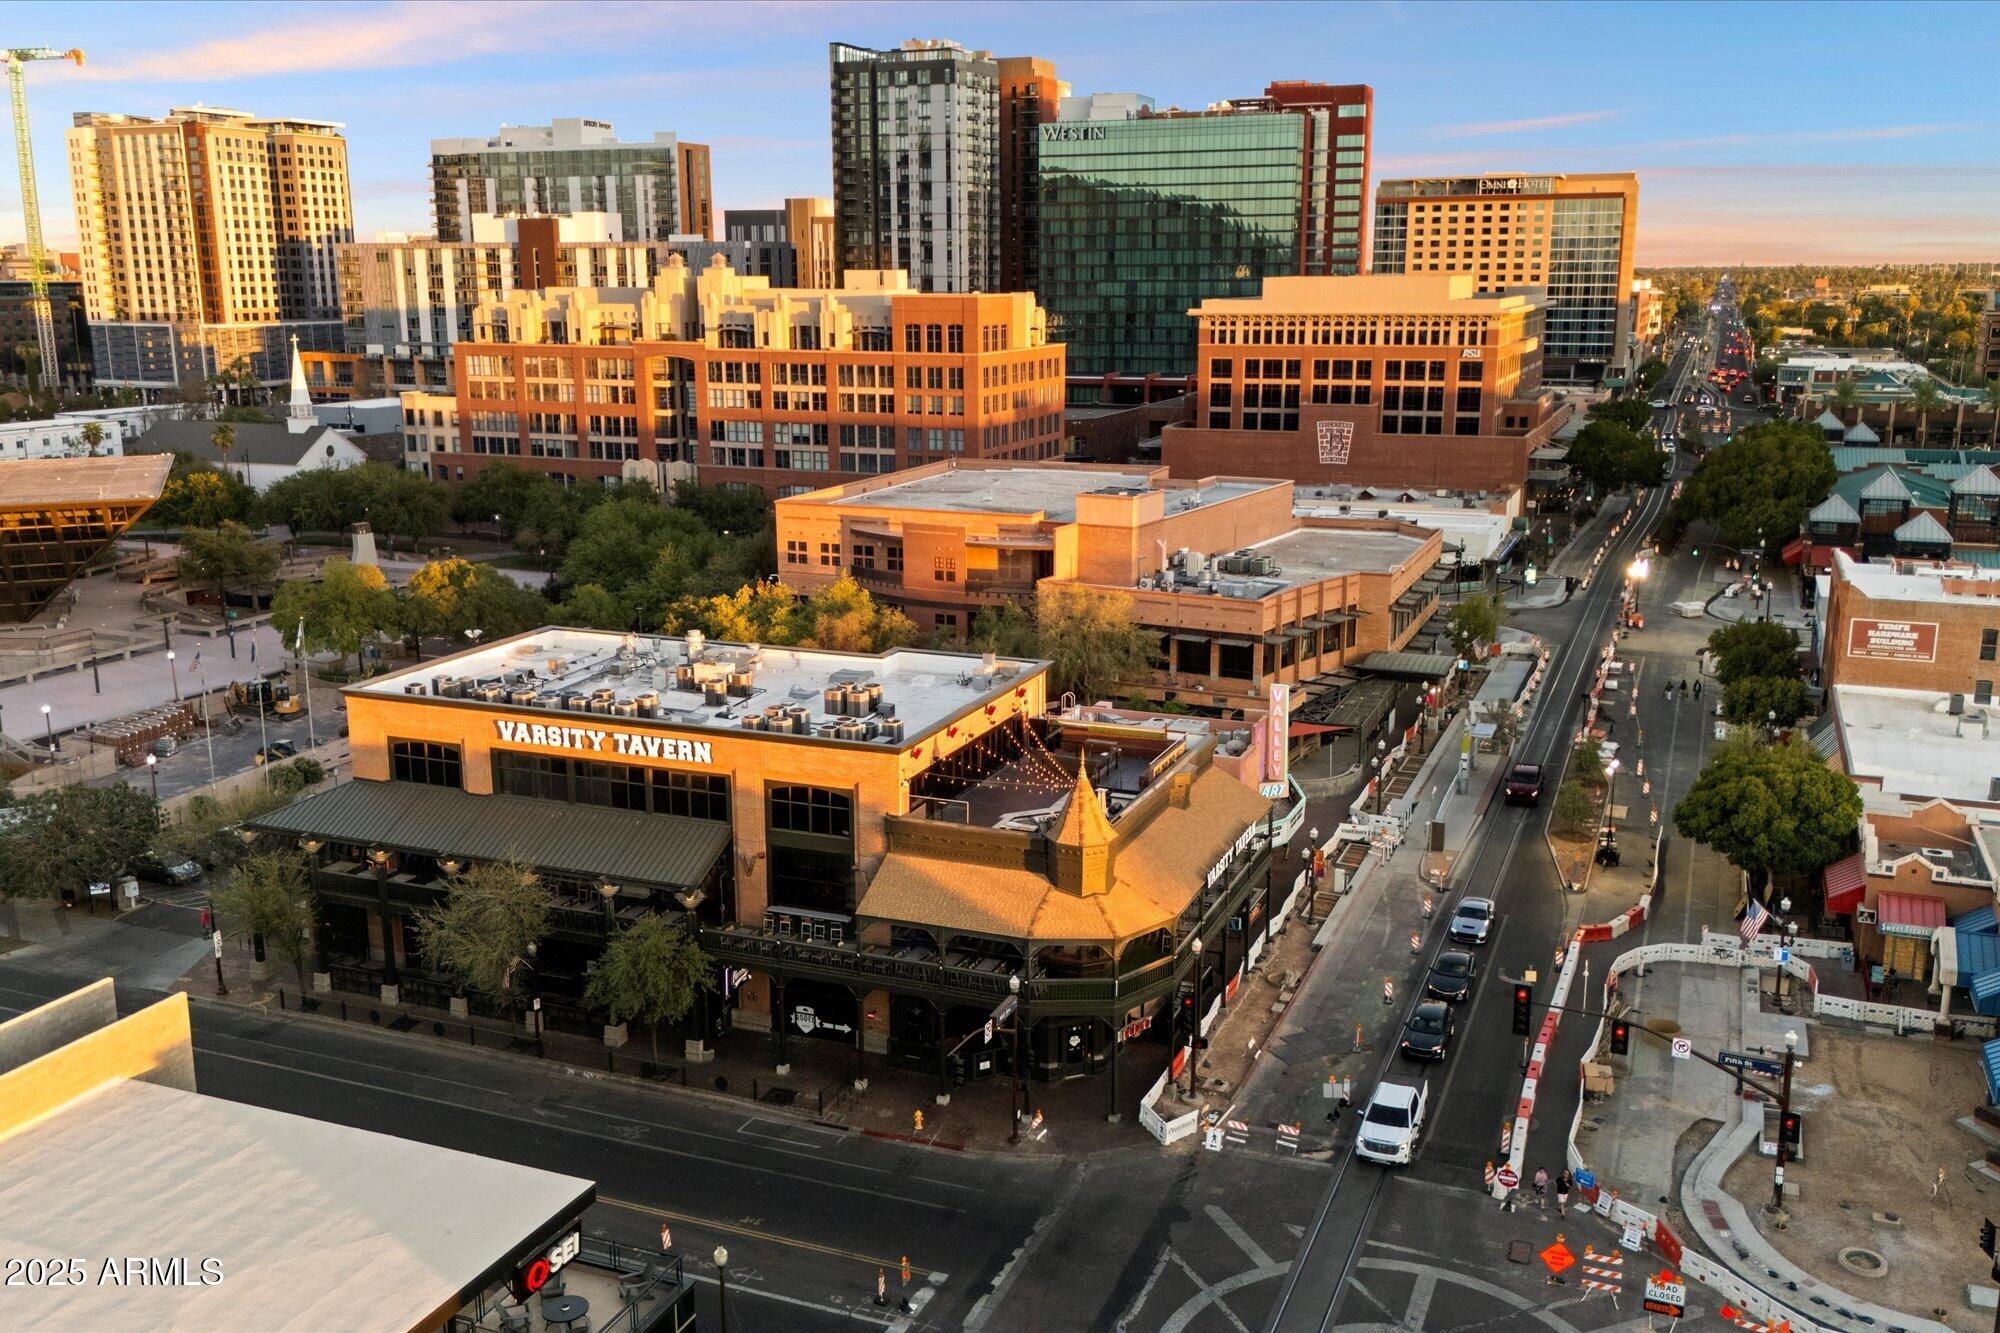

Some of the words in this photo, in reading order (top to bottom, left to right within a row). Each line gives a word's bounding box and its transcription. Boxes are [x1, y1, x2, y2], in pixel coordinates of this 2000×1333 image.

[1042, 125, 1105, 141] WESTIN
[1480, 179, 1506, 190] OMNI
[1518, 178, 1551, 189] HOTEL
[1877, 623, 1911, 632] TEMPE
[1867, 630, 1919, 640] HARDWARE
[1869, 638, 1915, 647] BUILDING
[1271, 689, 1283, 776] VALLEY
[498, 720, 605, 752] VARSITY
[613, 733, 713, 763] TAVERN
[1261, 784, 1284, 798] ART
[1207, 845, 1234, 889] VARSITY
[1235, 820, 1256, 856] TAVERN
[1881, 923, 1904, 932] Sweet
[1649, 1290, 1682, 1303] CLOSED
